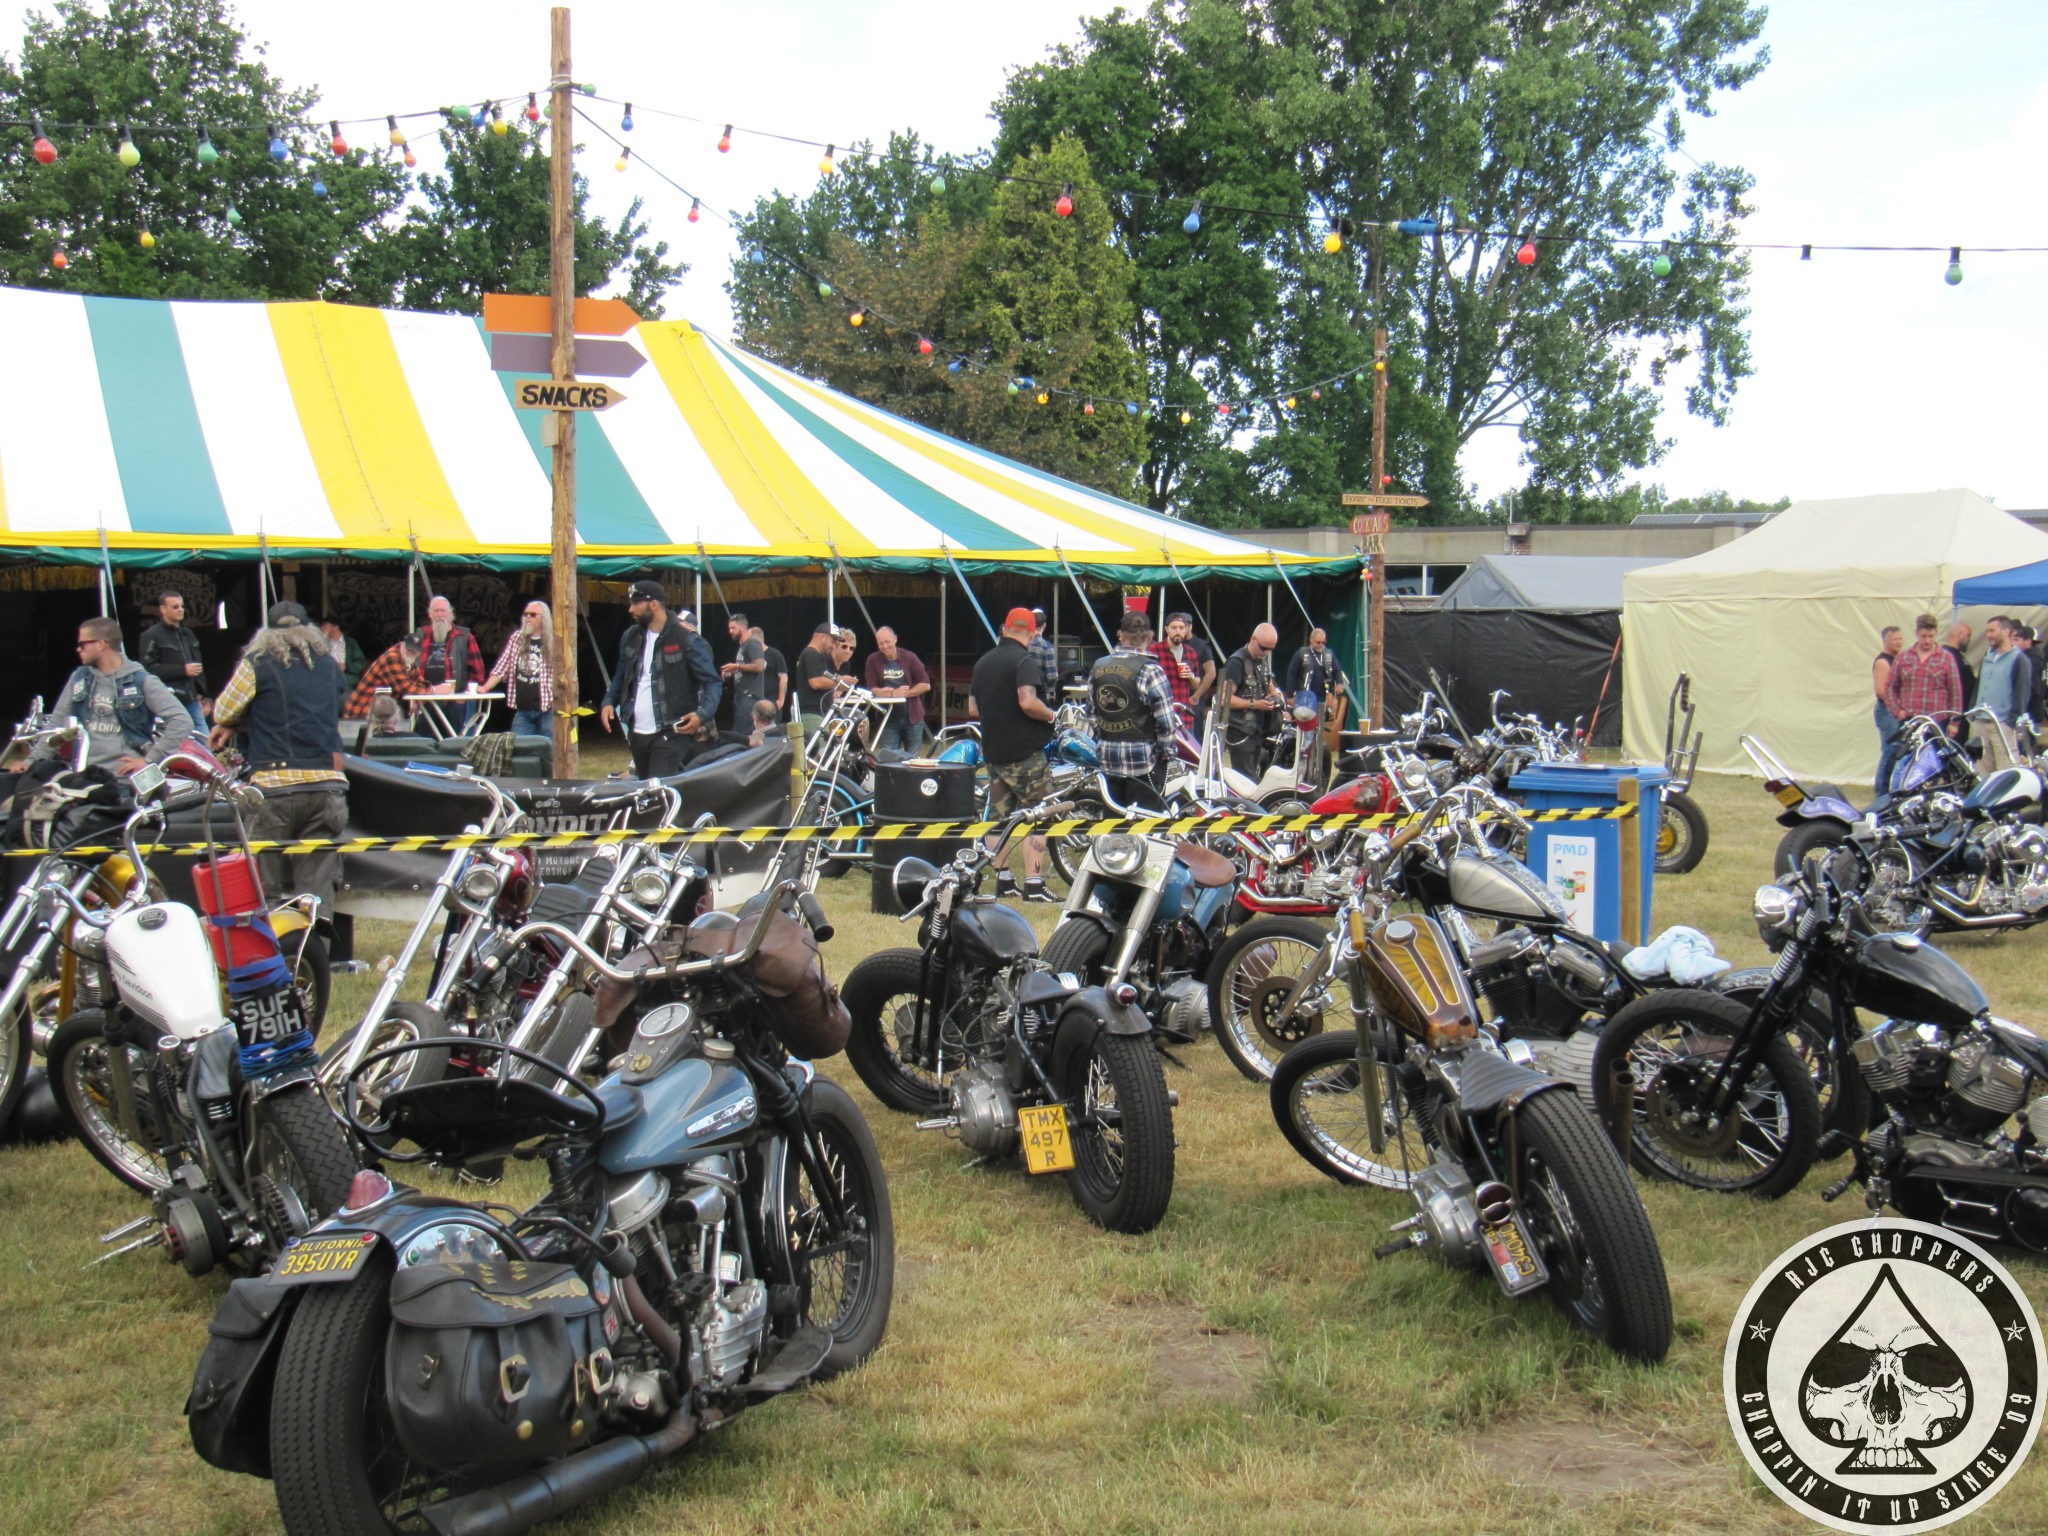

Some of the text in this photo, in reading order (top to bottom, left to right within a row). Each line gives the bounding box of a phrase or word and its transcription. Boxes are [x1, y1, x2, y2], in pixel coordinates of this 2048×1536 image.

[521, 384, 608, 410] SNACKS
[1363, 535, 1379, 553] BAR
[1553, 843, 1588, 856] PMD
[241, 990, 290, 1023] SUF
[242, 1009, 302, 1044] 791H
[1025, 1110, 1062, 1128] TMX
[1031, 1130, 1063, 1148] 497
[1045, 1151, 1057, 1166] R
[280, 1250, 360, 1276] 395UYR
